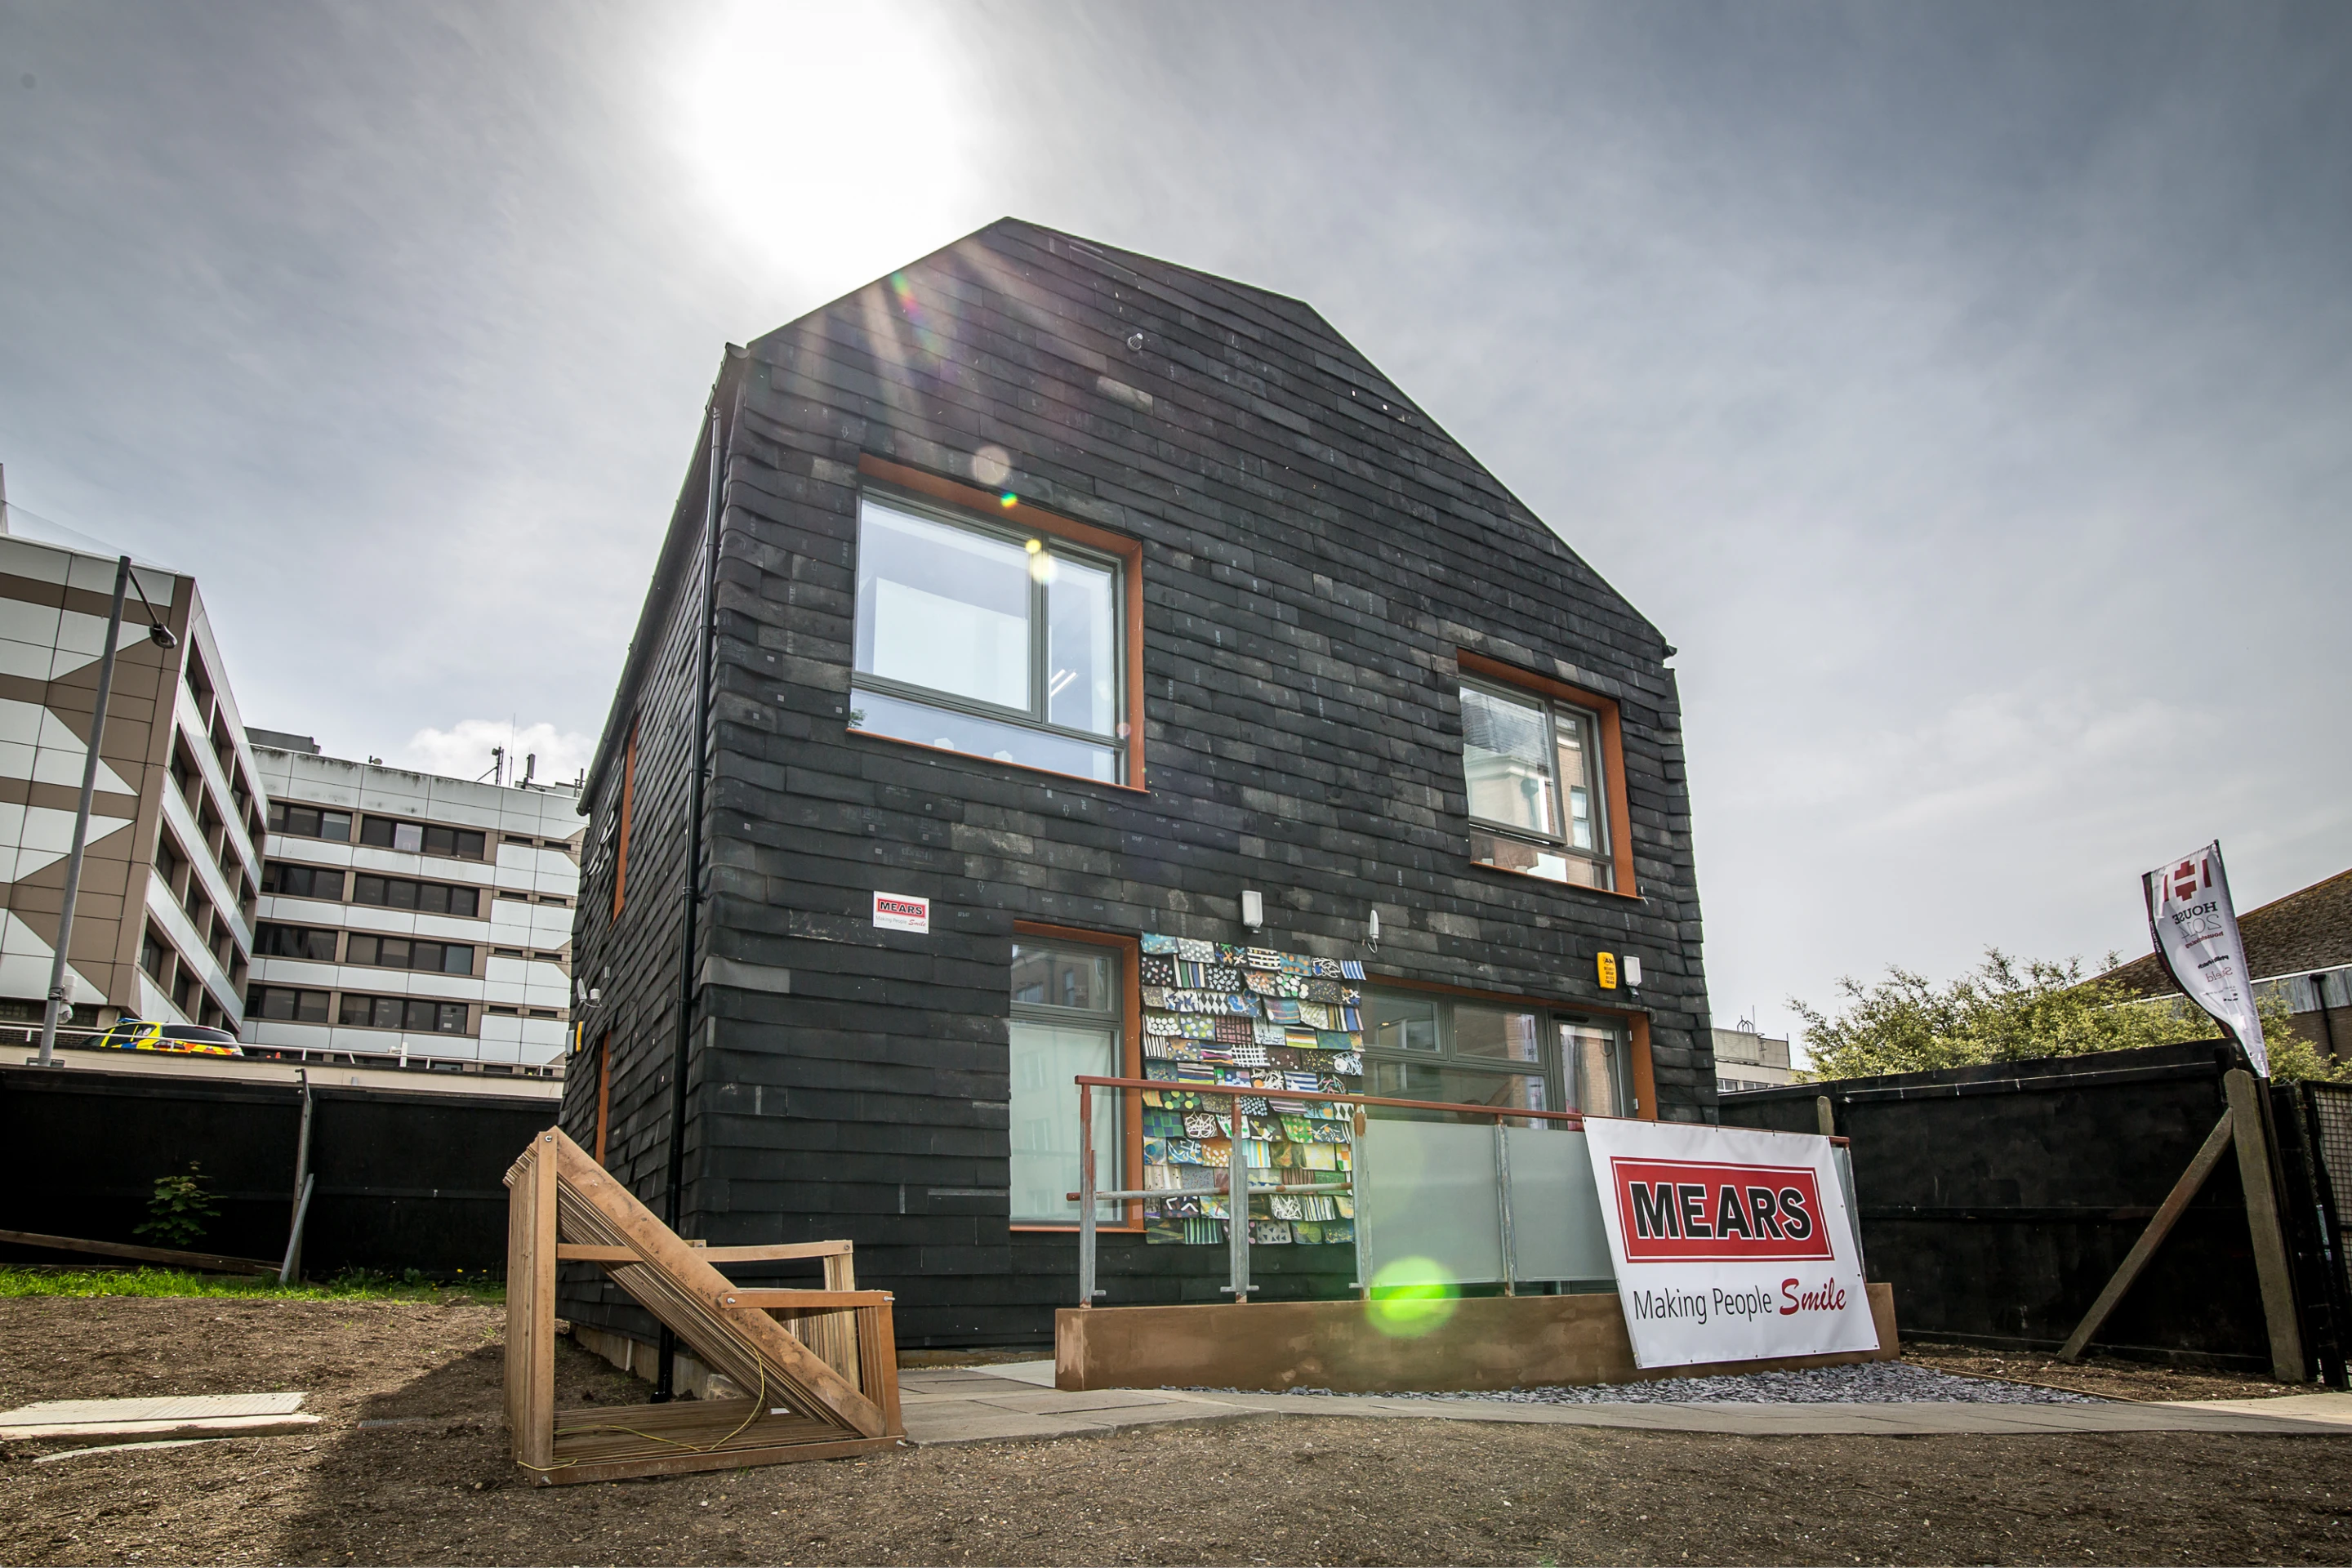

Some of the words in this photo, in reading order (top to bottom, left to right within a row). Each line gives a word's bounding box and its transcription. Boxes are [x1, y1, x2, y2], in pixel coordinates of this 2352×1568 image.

[875, 915, 892, 924] Making
[908, 919, 926, 927] Smile
[880, 901, 923, 915] MEARS
[1628, 1181, 1812, 1241] MEARS
[1633, 1288, 1708, 1325] Making
[1713, 1285, 1772, 1322] People
[1780, 1277, 1846, 1316] Smile
